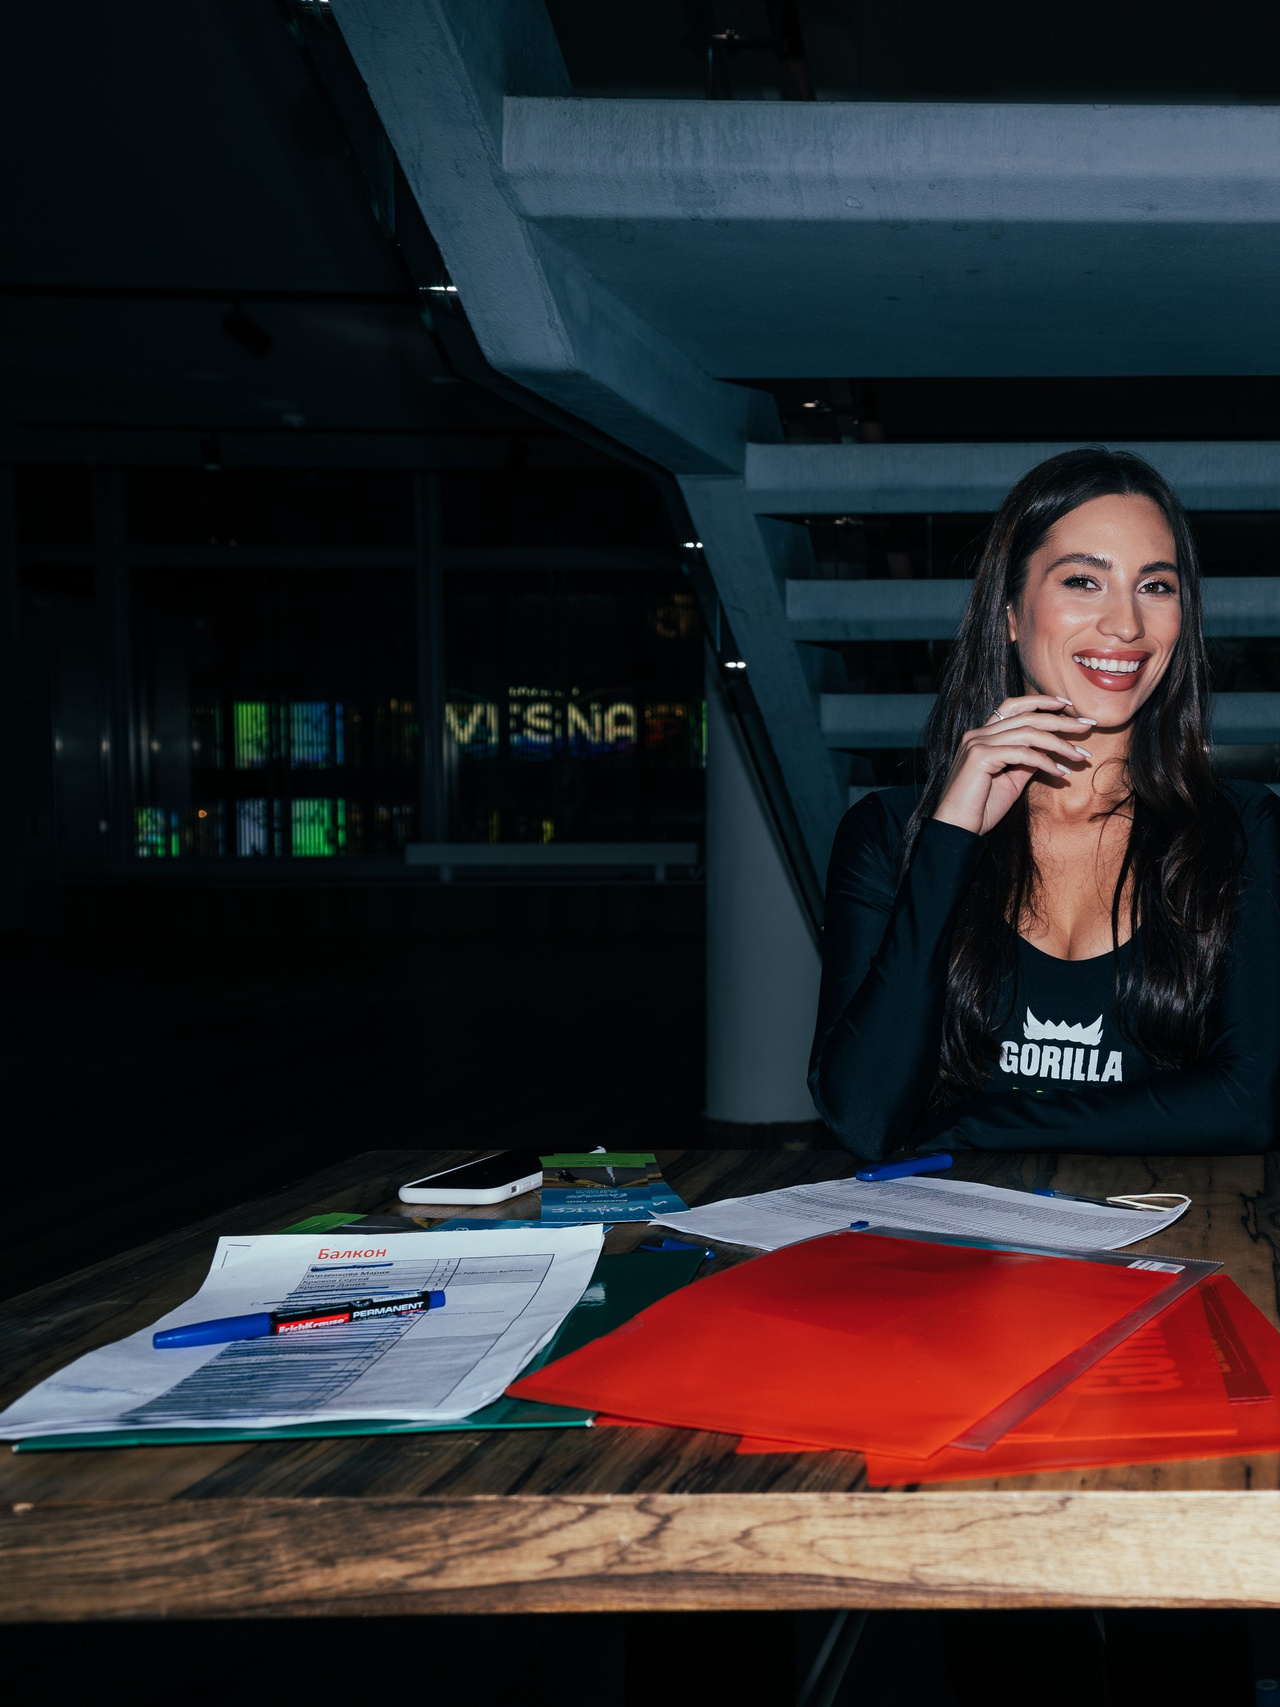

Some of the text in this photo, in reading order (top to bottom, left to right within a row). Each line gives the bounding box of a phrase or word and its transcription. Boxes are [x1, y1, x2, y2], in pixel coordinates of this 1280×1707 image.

[445, 702, 638, 745] VESNA
[999, 1040, 1122, 1082] GORILLA
[317, 1248, 387, 1260] Балкон
[278, 1317, 348, 1335] ErichKrause
[352, 1301, 424, 1319] PERMANENT
